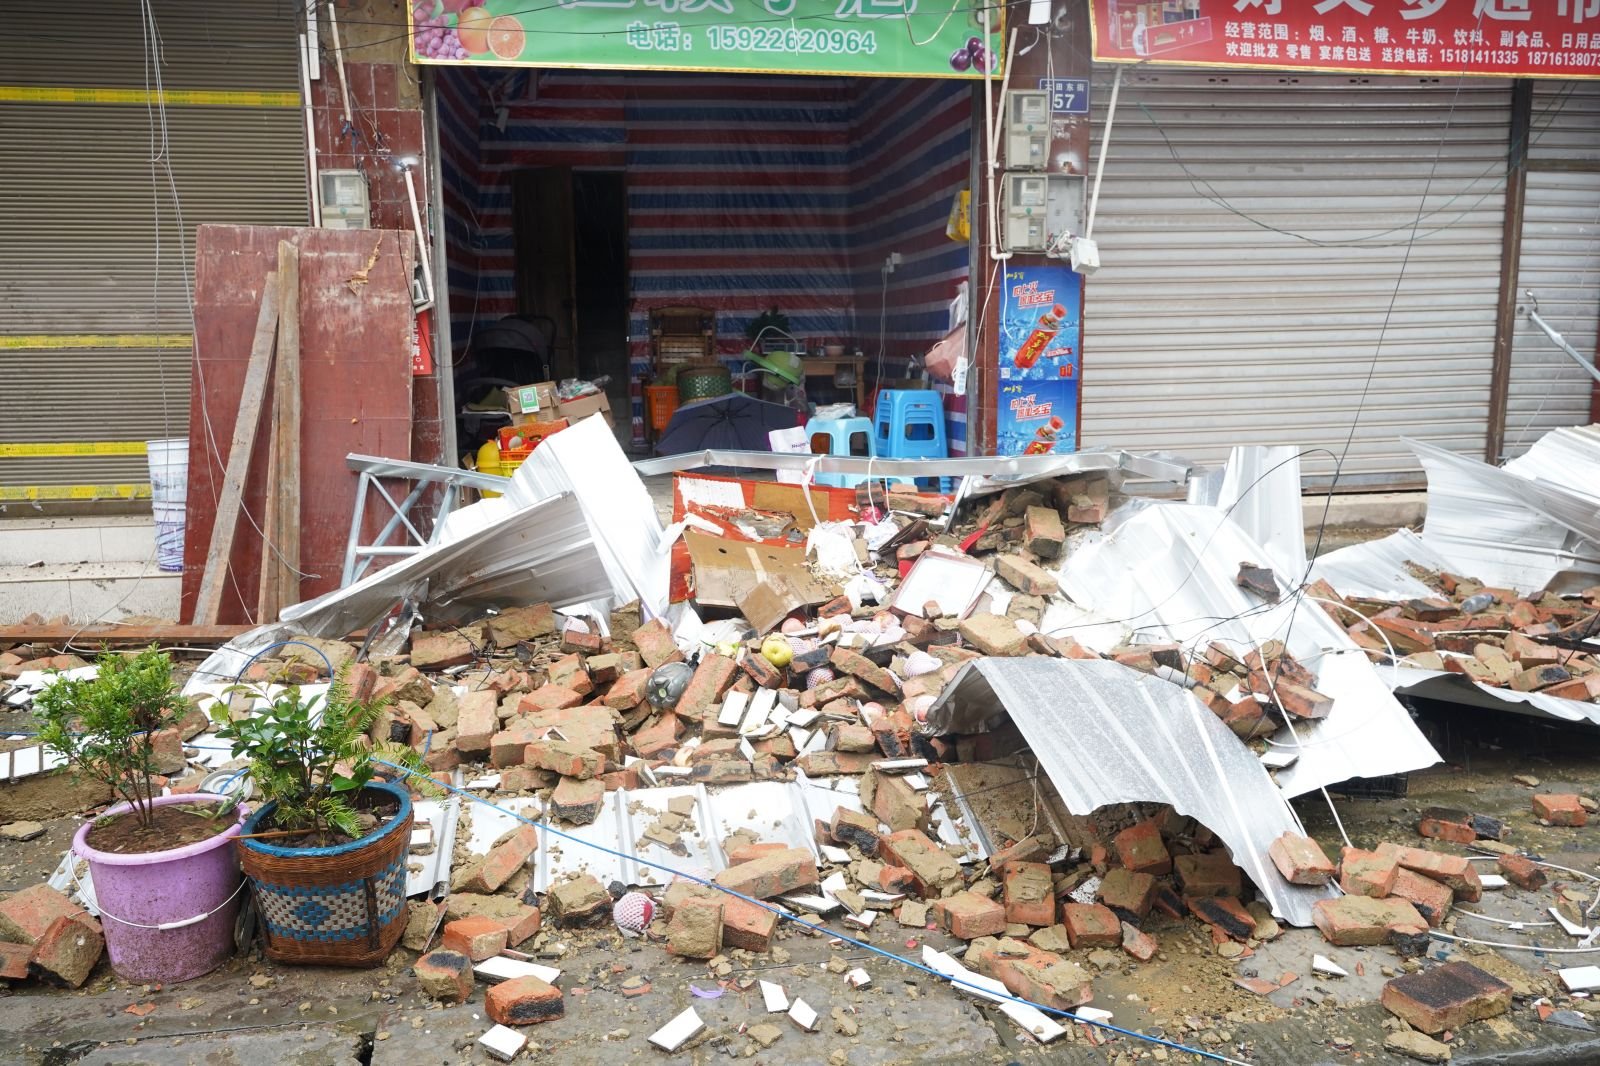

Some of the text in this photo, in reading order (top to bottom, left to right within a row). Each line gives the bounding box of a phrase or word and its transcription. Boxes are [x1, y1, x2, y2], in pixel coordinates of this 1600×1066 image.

[706, 25, 877, 54] 15922620964
[1225, 41, 1279, 59] 欢迎批发
[1286, 43, 1311, 60] 零售
[1319, 45, 1371, 62] 宴席包送
[1439, 48, 1519, 65] 15181411335
[1527, 50, 1600, 67] 18716138073
[1053, 93, 1075, 109] 57
